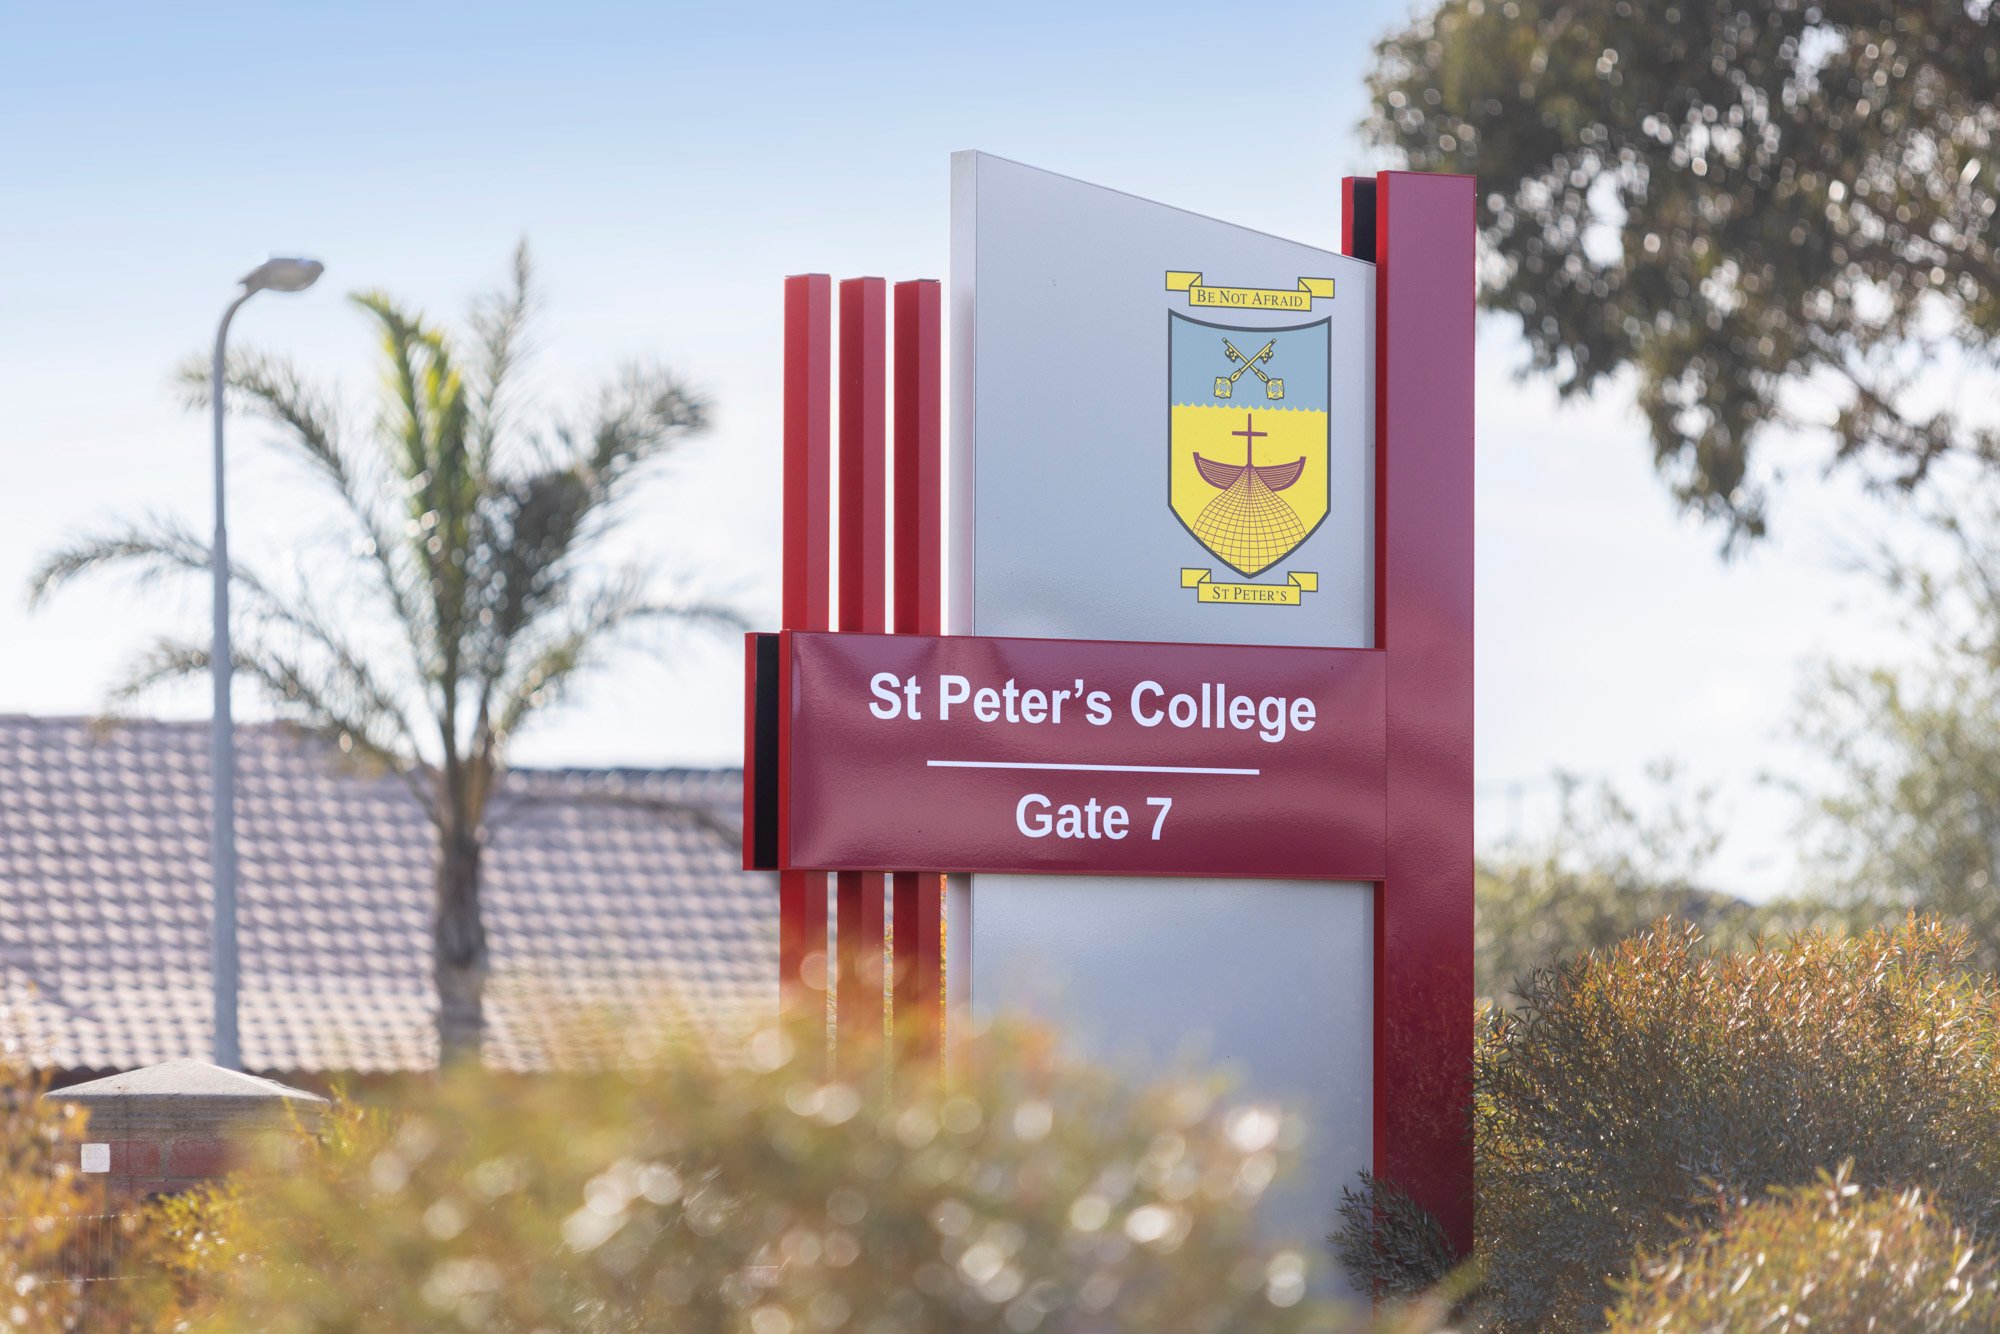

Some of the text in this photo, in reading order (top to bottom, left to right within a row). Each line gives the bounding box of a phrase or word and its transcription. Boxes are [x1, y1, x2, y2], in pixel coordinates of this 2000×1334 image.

[868, 672, 1317, 743] St Peter’s College
[1015, 793, 1173, 841] Gate 7
